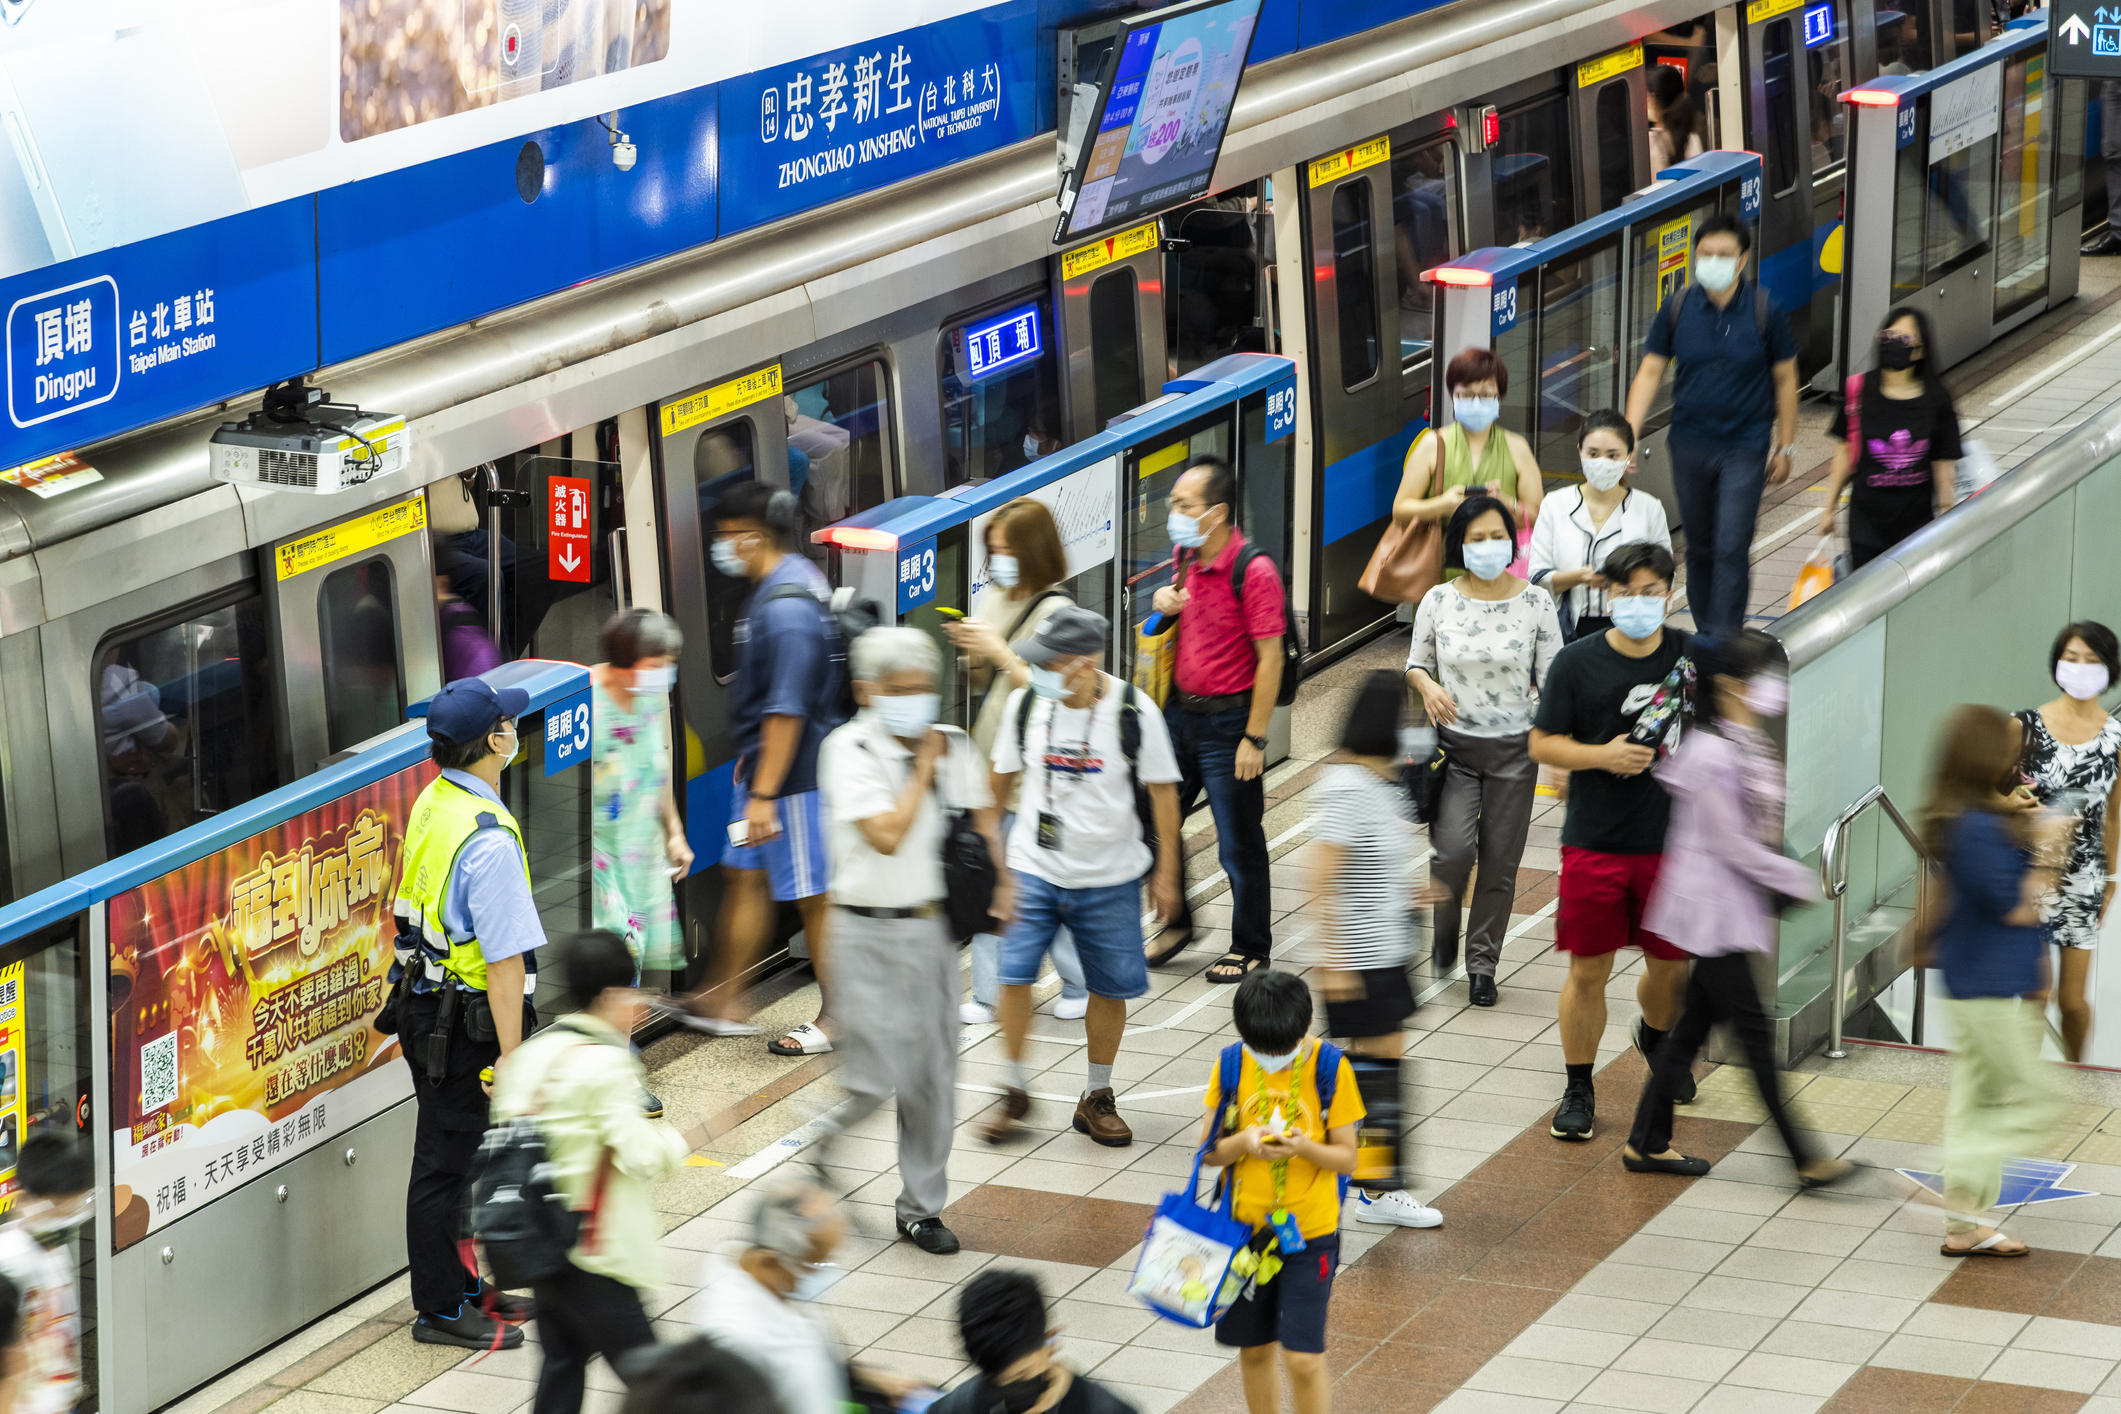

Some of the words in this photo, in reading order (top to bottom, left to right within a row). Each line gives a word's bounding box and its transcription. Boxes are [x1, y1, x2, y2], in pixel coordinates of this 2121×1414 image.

[765, 95, 776, 115] BL
[784, 45, 912, 141] 忠孝新生
[765, 118, 776, 136] 14
[922, 112, 949, 131] NATIONAL
[950, 107, 967, 122] TAIPEI
[967, 97, 997, 118] UNIVERSITY
[936, 127, 945, 139] OF
[946, 115, 982, 136] TECHNOLOGY
[1908, 106, 1915, 136] 3
[778, 144, 855, 188] ZHONGXIAO
[858, 124, 916, 164] XINSHENG
[1752, 176, 1760, 208] 3
[129, 288, 214, 347] 台北車站
[1508, 286, 1516, 322] 3
[35, 298, 92, 367] 頂埔
[986, 318, 1031, 364] 頂埔
[128, 350, 156, 375] Taipei
[157, 341, 181, 365] Main
[182, 333, 216, 357] Station
[35, 366, 96, 404] Dingpu
[1274, 418, 1284, 430] Car
[1284, 386, 1294, 426] 3
[554, 485, 566, 526] 滅火器
[900, 554, 921, 584] 車廂
[921, 548, 934, 592] 3
[908, 584, 921, 598] Car
[547, 708, 572, 742] 車廂
[574, 702, 590, 750] 3
[558, 742, 573, 758] Car
[234, 816, 384, 956] 福到你家
[247, 979, 381, 1068] 千萬人共振福到你家
[133, 1112, 166, 1145] 福到你家
